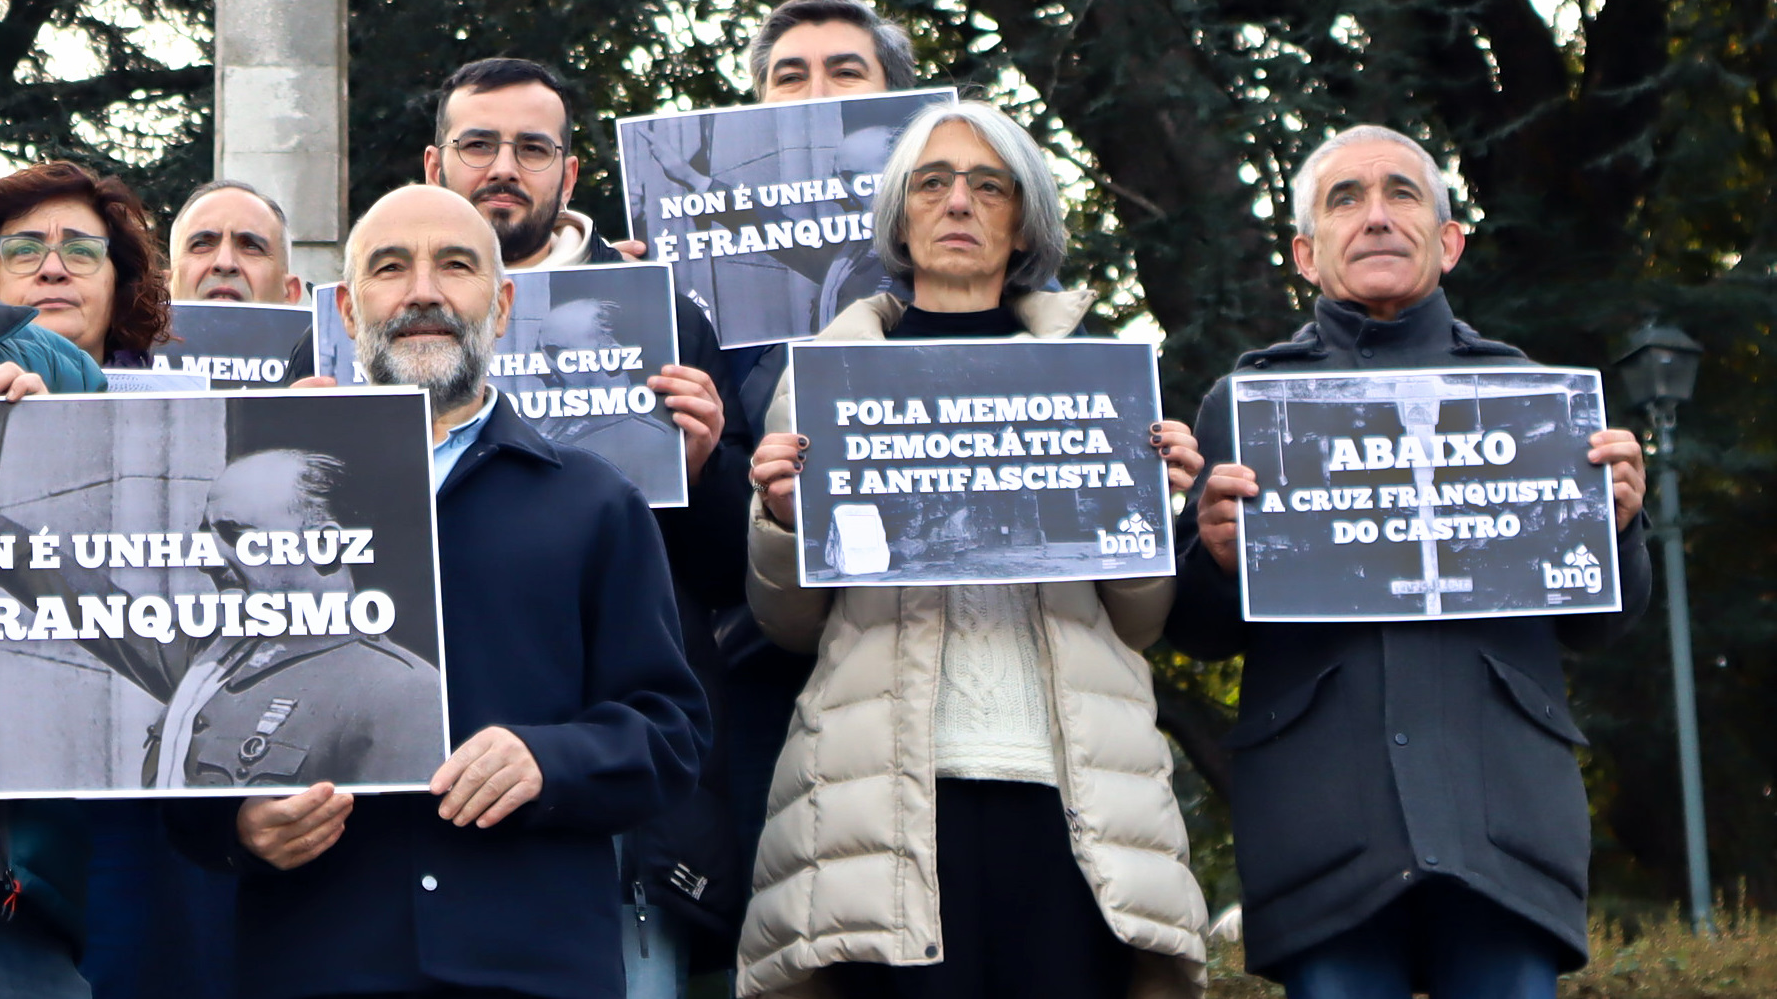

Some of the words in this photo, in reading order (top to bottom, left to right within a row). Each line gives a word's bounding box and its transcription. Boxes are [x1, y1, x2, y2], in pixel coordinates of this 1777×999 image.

[660, 190, 726, 220] NON
[733, 184, 753, 212] É
[757, 177, 848, 209] UNHA
[654, 230, 680, 263] É
[181, 355, 290, 382] MEMO
[486, 352, 551, 376] NHA
[557, 347, 643, 374] CRUZ
[836, 399, 931, 427] POLA
[938, 393, 1118, 425] MEMORIA
[846, 425, 1113, 461] DEMOCRÁTICA
[1329, 431, 1517, 472] ABAIXO
[828, 471, 852, 495] E
[860, 462, 1135, 494] ANTIFASCISTA
[1262, 491, 1286, 513] A
[1291, 487, 1374, 513] CRUZ
[1379, 478, 1583, 510] FRANQUISTA
[1097, 530, 1157, 559] bng
[1334, 520, 1379, 545] DO
[1385, 514, 1521, 543] CASTRO
[29, 526, 61, 570] É
[72, 532, 226, 569] UNHA
[235, 528, 375, 567] CRUZ
[1543, 562, 1603, 594] bng
